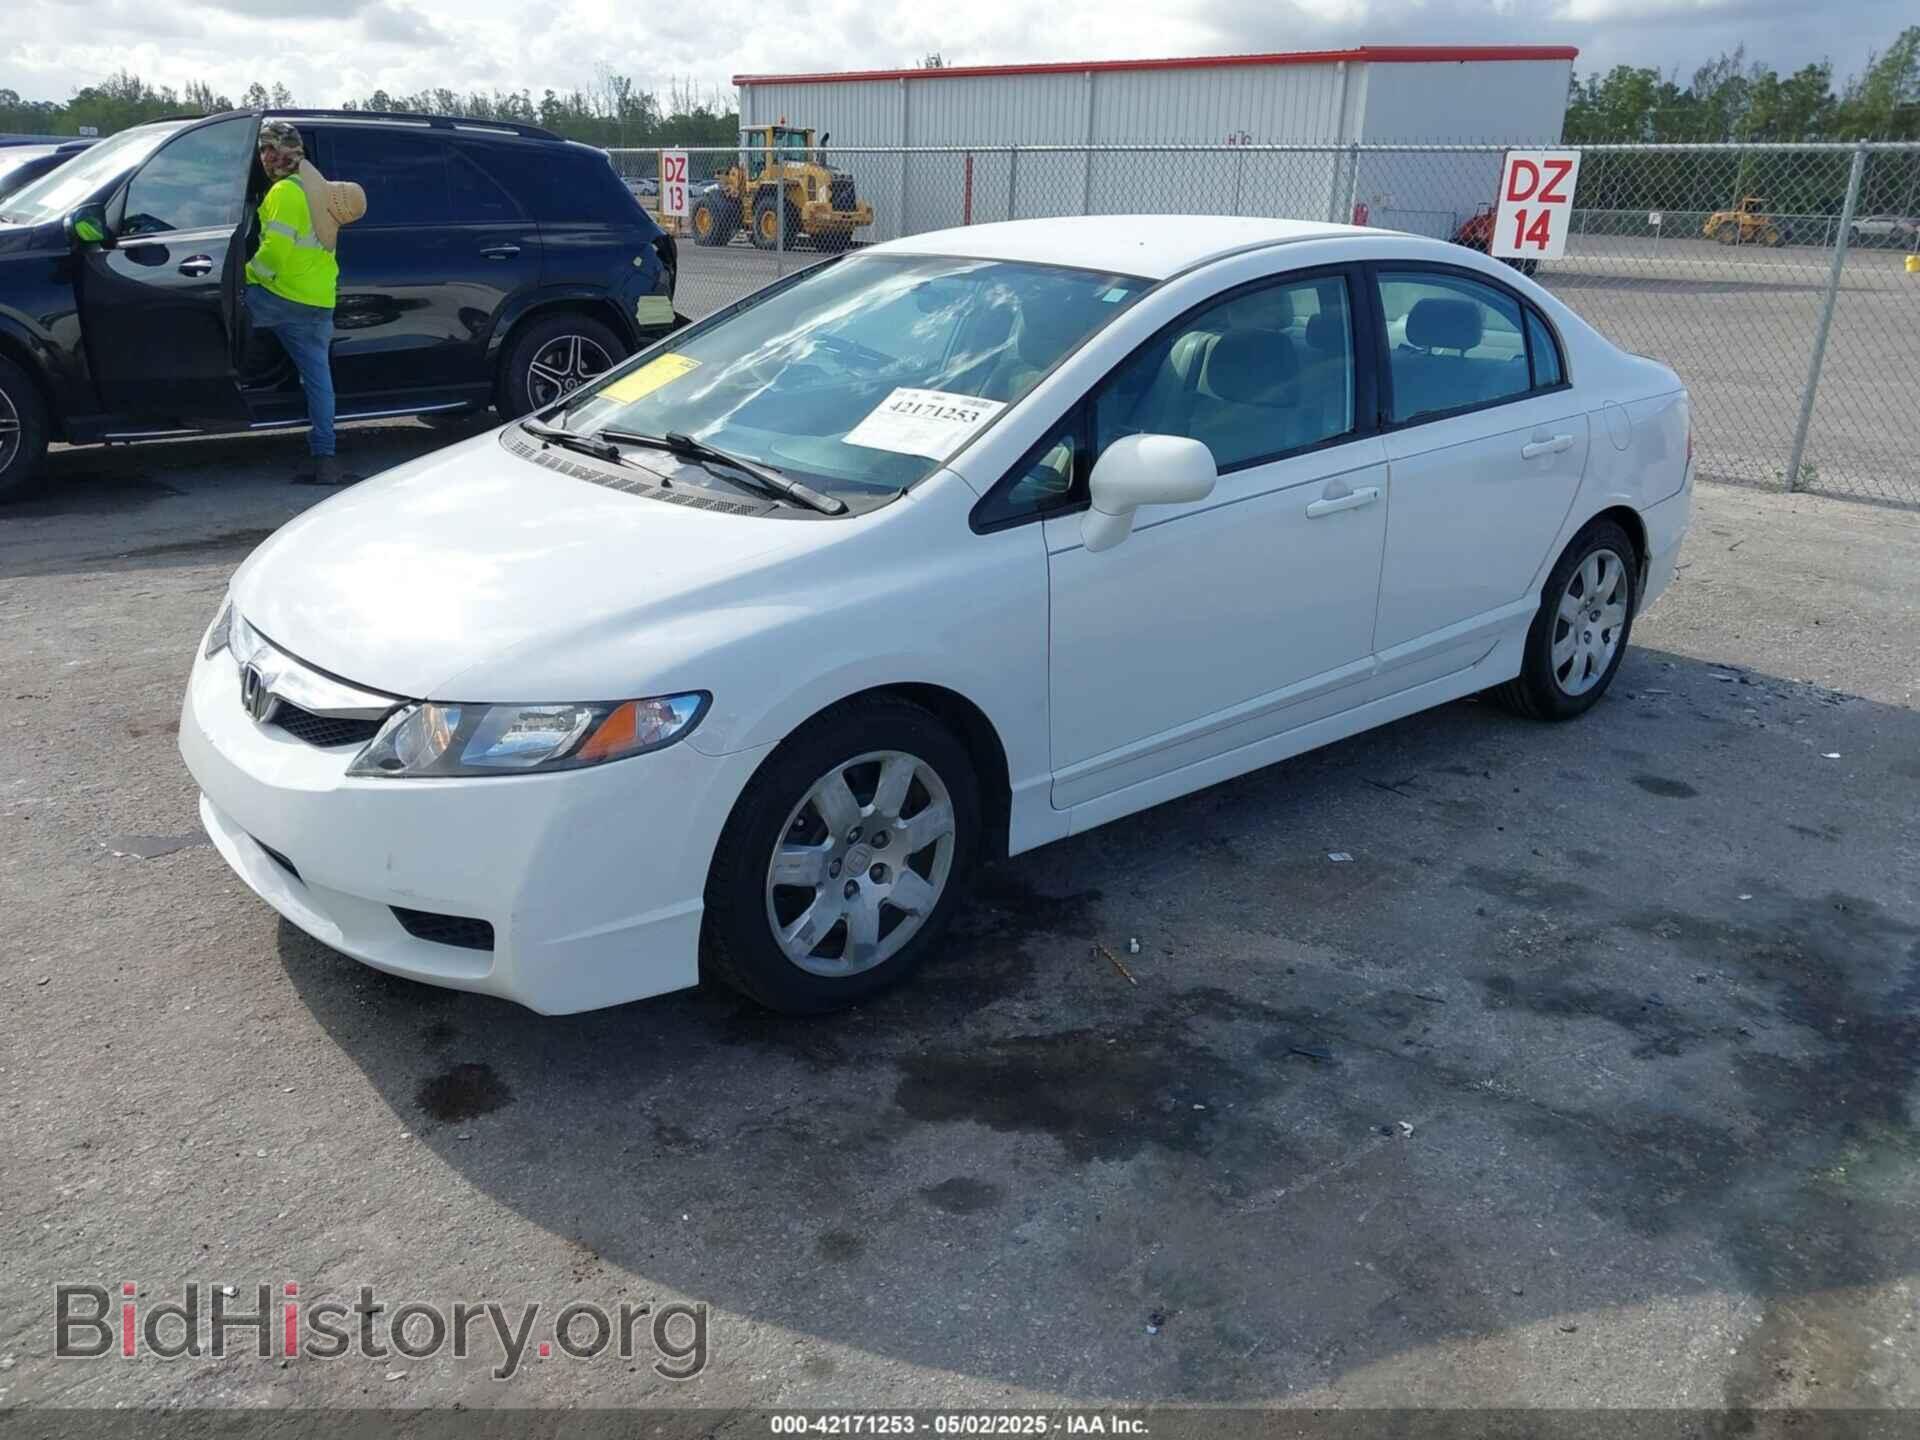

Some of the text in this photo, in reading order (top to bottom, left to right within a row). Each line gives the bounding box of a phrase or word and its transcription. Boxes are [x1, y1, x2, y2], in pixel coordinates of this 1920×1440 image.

[664, 157, 686, 183] DZ
[1507, 159, 1573, 203] DZ
[669, 186, 684, 211] 13
[1514, 209, 1552, 250] 14
[889, 401, 980, 423] 42171253
